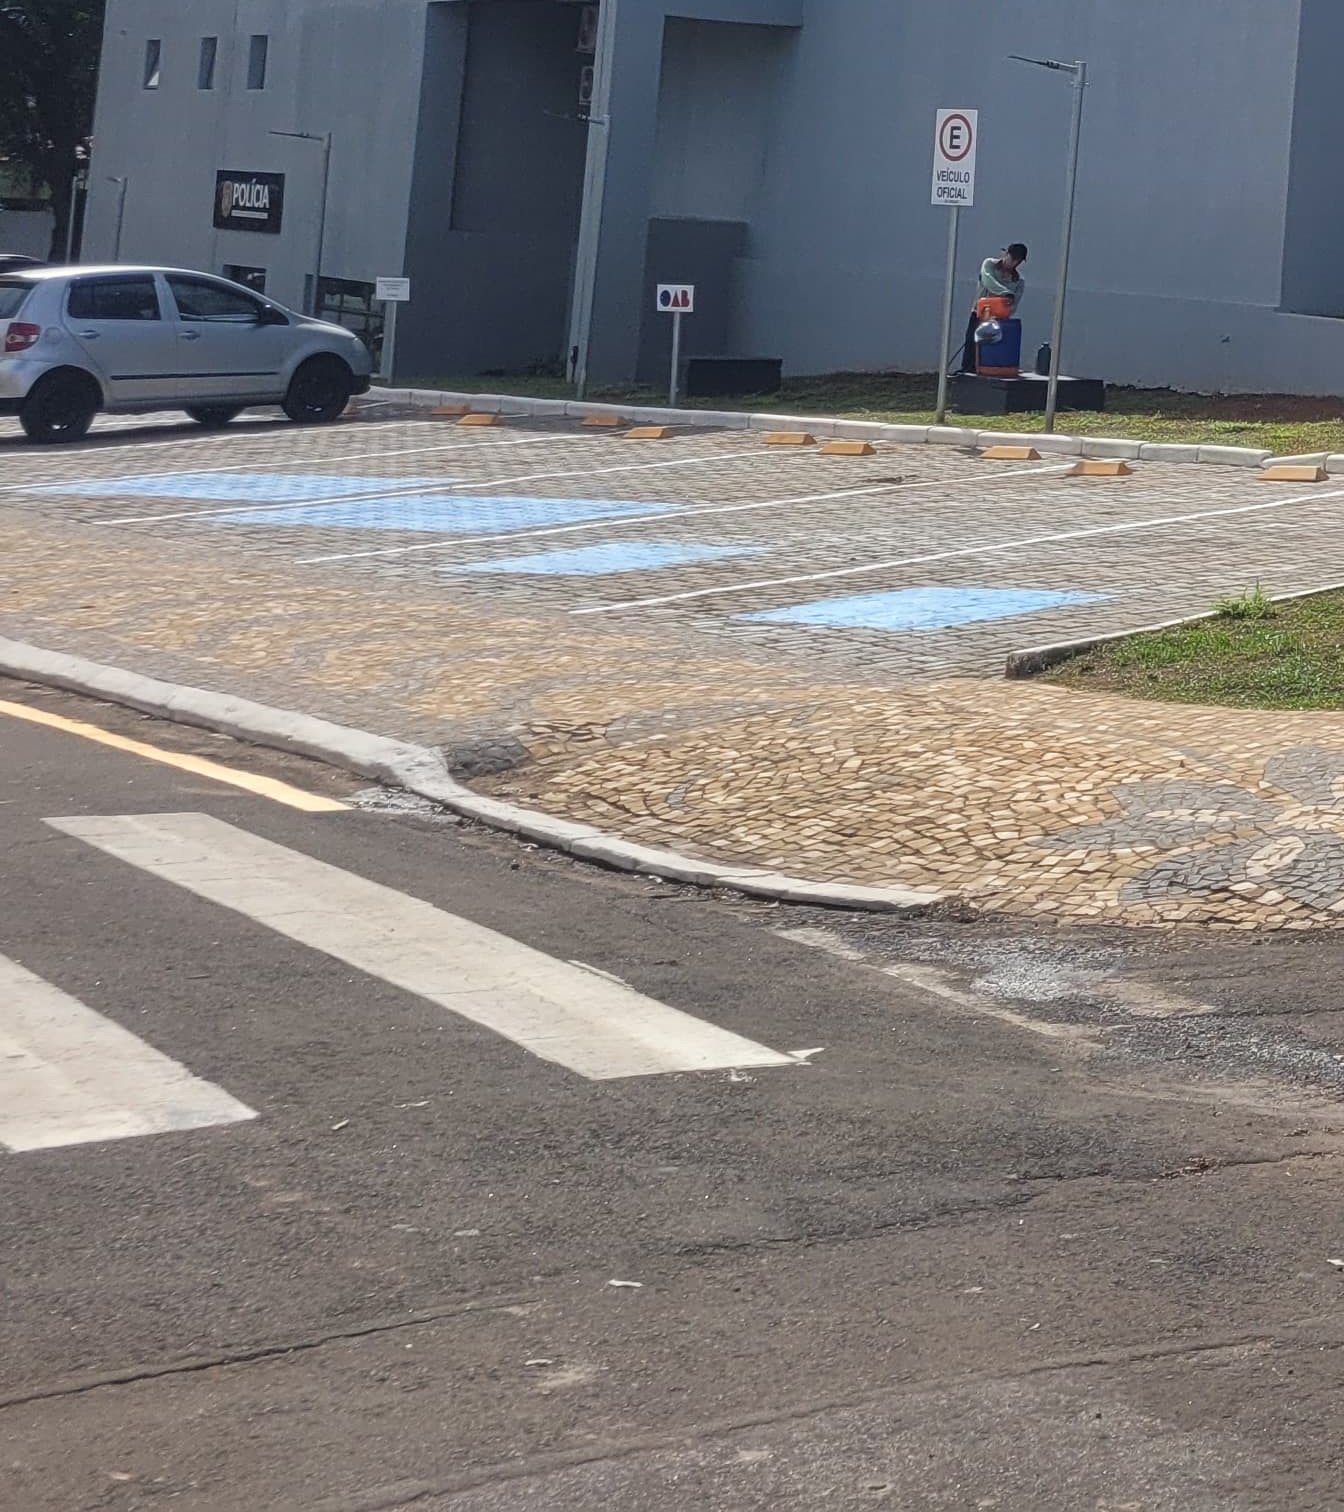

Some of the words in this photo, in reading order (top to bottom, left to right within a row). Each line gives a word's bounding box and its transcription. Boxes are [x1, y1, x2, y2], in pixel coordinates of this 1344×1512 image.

[949, 125, 962, 150] E
[936, 168, 970, 184] VEÍCULO
[232, 178, 270, 209] POLÍCIA
[936, 186, 968, 199] OFICIAL
[659, 289, 690, 308] OAB
